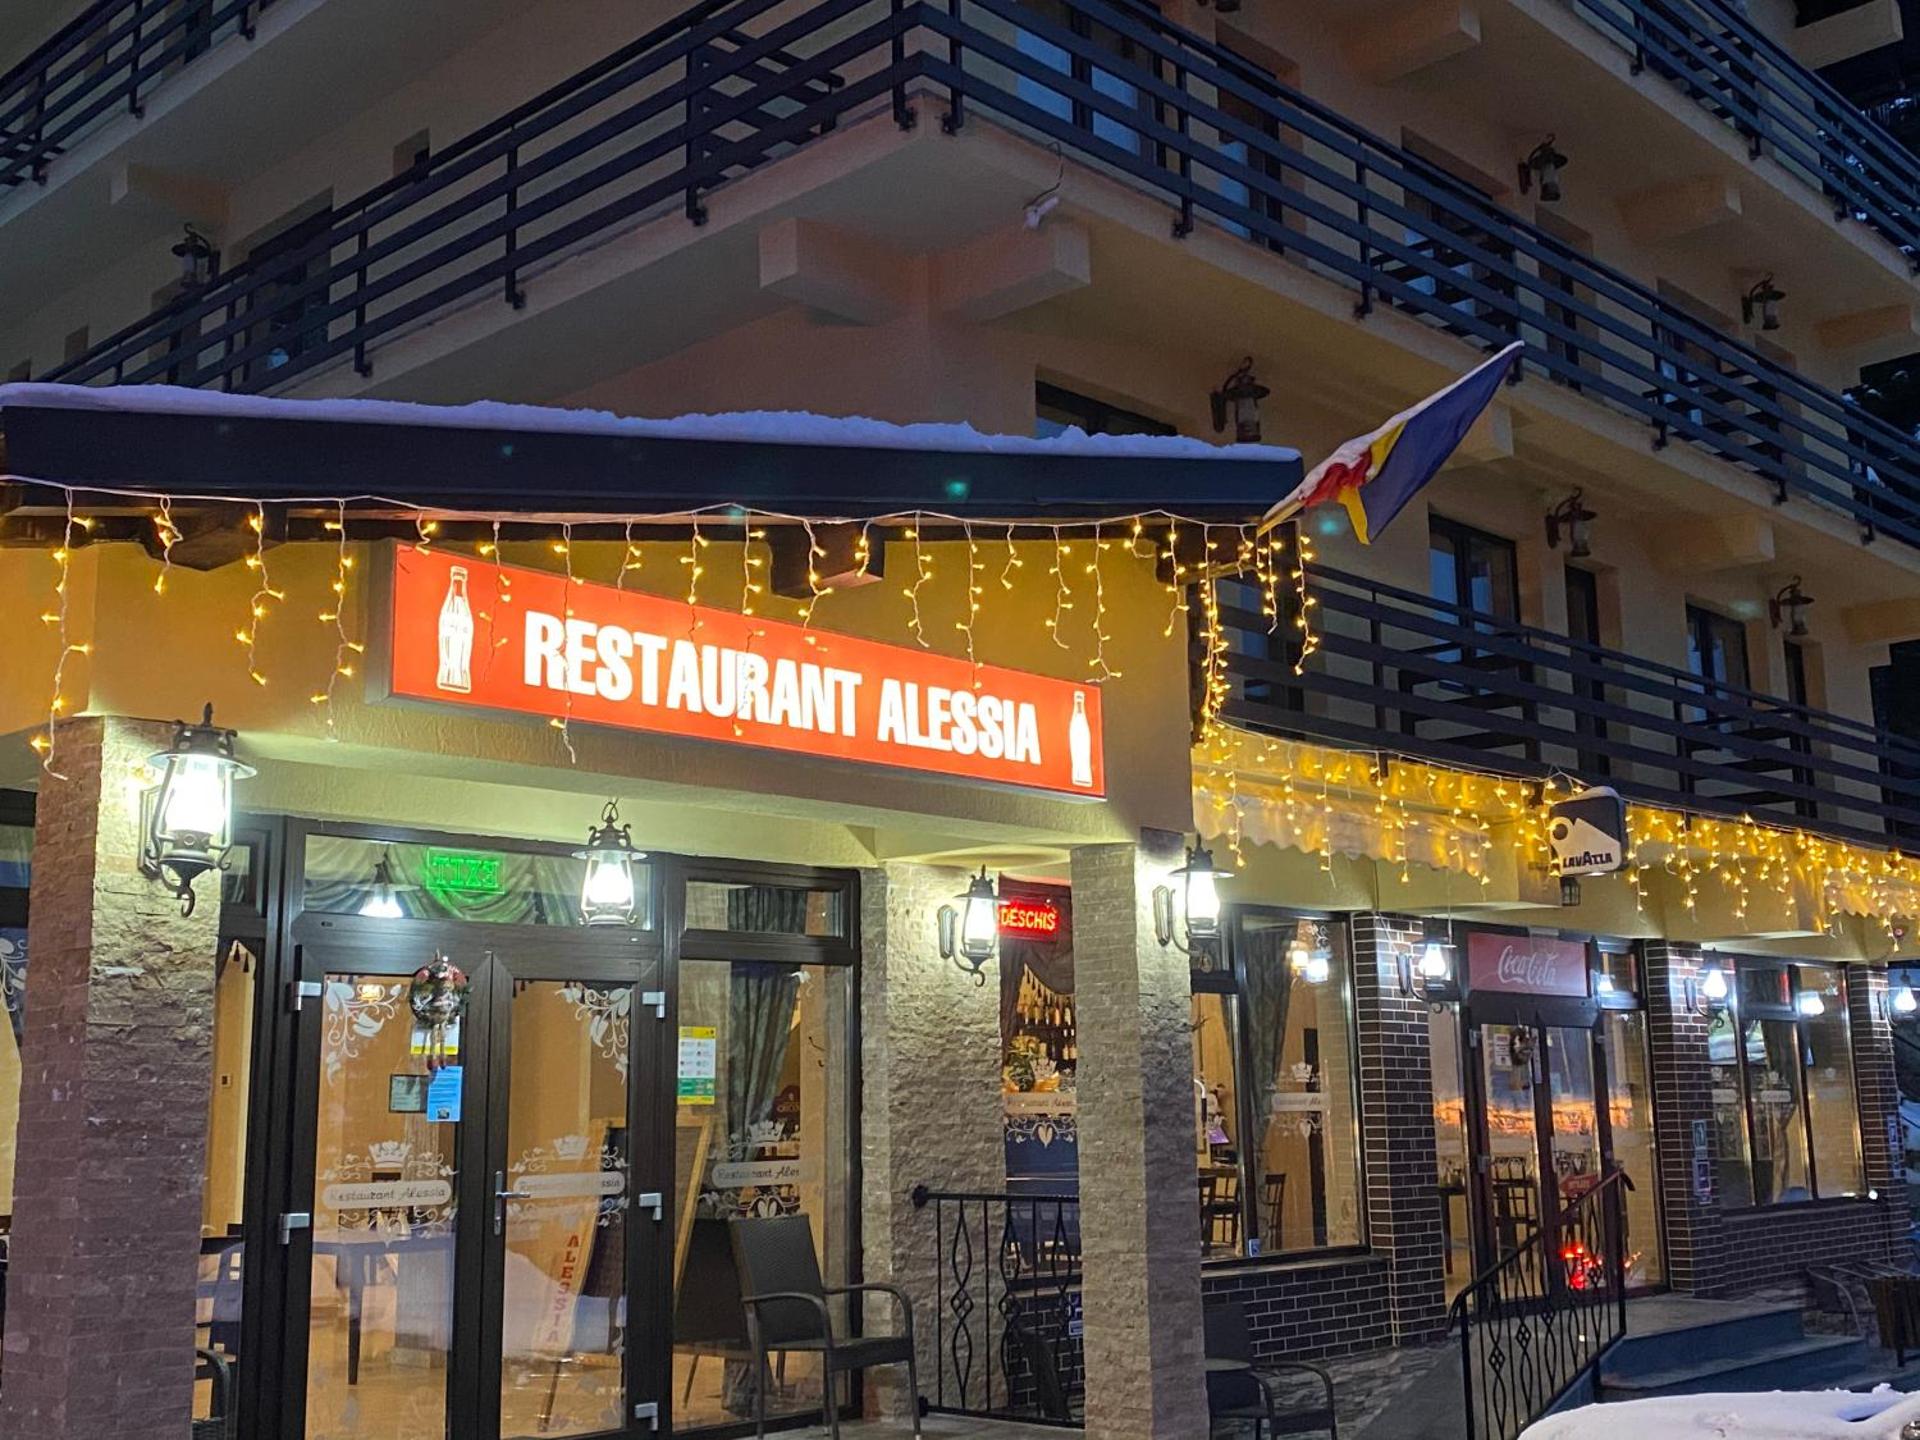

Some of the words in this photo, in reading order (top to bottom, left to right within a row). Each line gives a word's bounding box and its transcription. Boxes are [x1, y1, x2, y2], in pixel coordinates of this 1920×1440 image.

[523, 610, 863, 738] RESTAURANT
[876, 677, 1042, 765] ALESSIA
[1562, 850, 1613, 868] LAVAZZA
[1000, 906, 1056, 931] DESCHIS
[546, 1234, 580, 1342] ALESSIA
